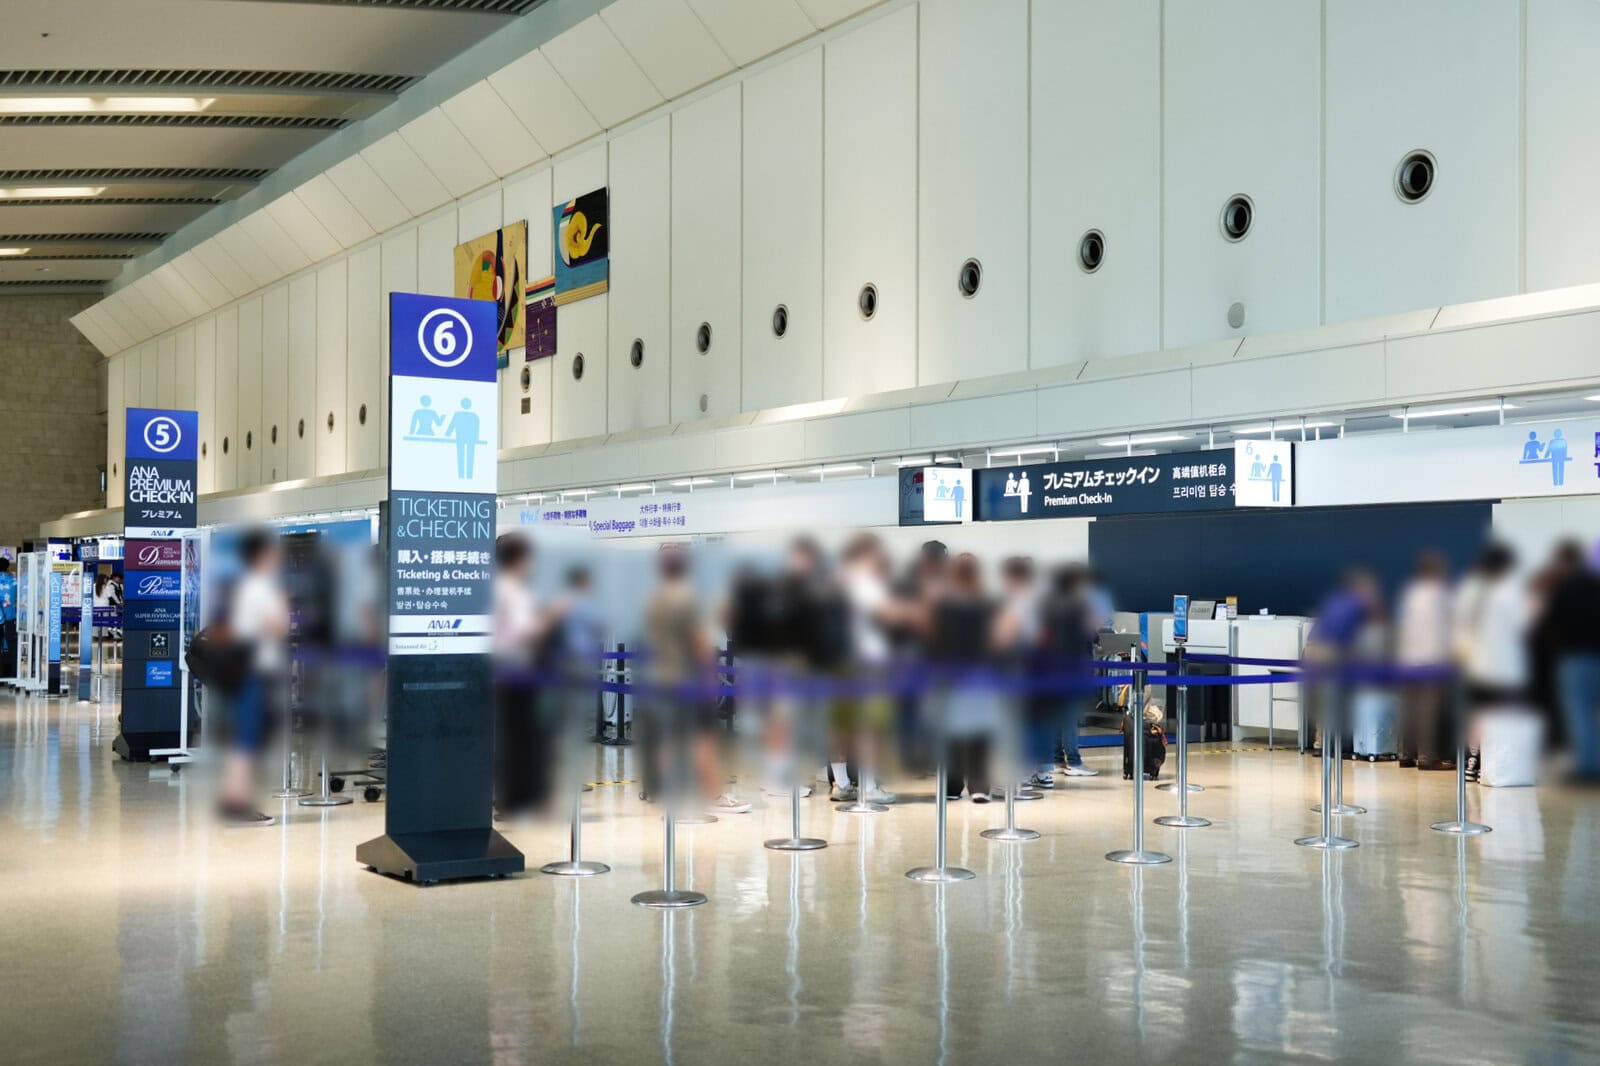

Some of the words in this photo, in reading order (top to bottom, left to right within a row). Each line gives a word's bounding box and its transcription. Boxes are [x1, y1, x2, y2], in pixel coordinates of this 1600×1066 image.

[433, 320, 456, 356] 6
[155, 424, 170, 446] 5
[1245, 442, 1254, 455] 6
[130, 466, 160, 479] ANA
[1043, 466, 1160, 490] プレミアムチェックイン
[130, 478, 191, 492] PREMIUM
[1172, 485, 1206, 499] 프리미엄
[1209, 484, 1227, 497] 탑승
[129, 490, 194, 504] CHECK-IN
[1044, 494, 1078, 507] Premium
[1079, 492, 1112, 504] Check-In
[141, 510, 182, 519] プレミアム
[397, 498, 490, 519] TICKETING
[473, 521, 490, 540] IN
[593, 519, 611, 532] Special
[612, 519, 635, 532] Baggage
[397, 569, 440, 582] Ticketing
[442, 570, 450, 580] &
[451, 569, 480, 580] Check
[427, 619, 452, 630] ANA
